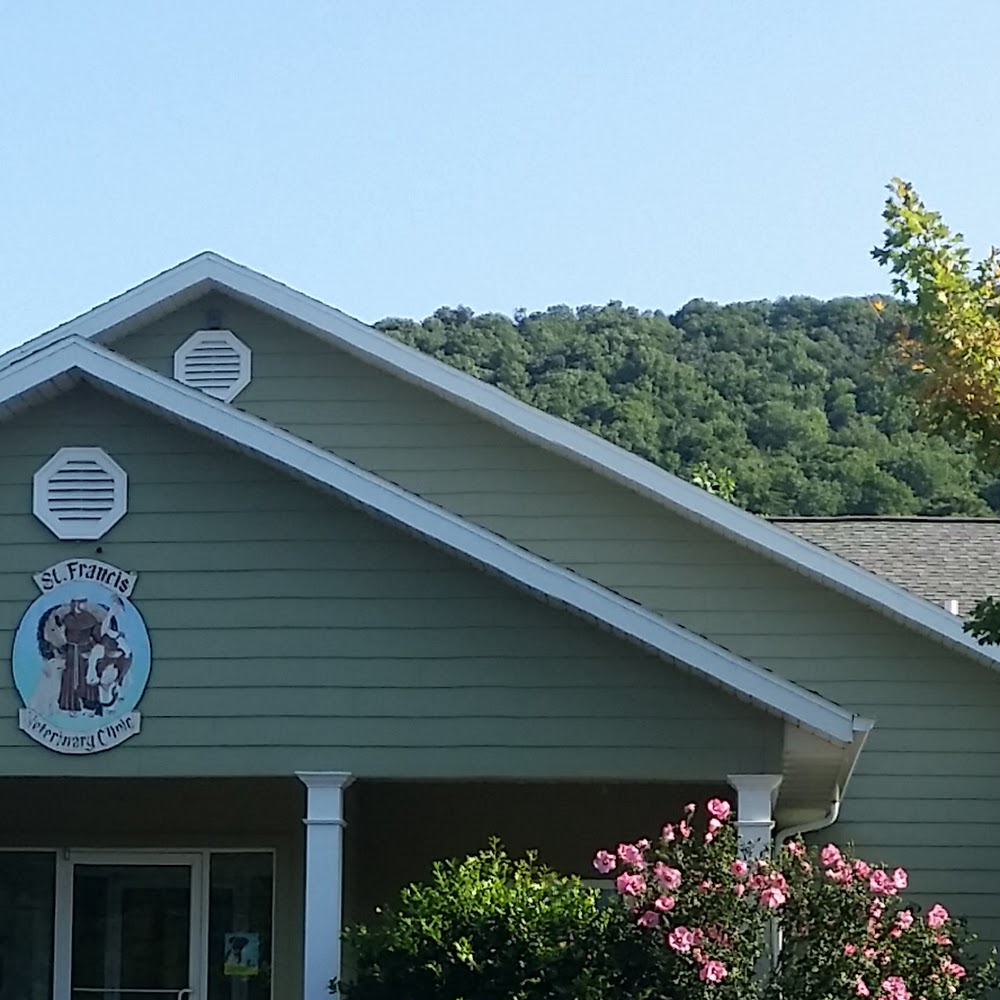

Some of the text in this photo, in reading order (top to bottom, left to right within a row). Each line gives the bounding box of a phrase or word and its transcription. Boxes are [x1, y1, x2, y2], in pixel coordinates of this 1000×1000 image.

[41, 562, 129, 593] St. Francis
[97, 717, 132, 746] Clinic
